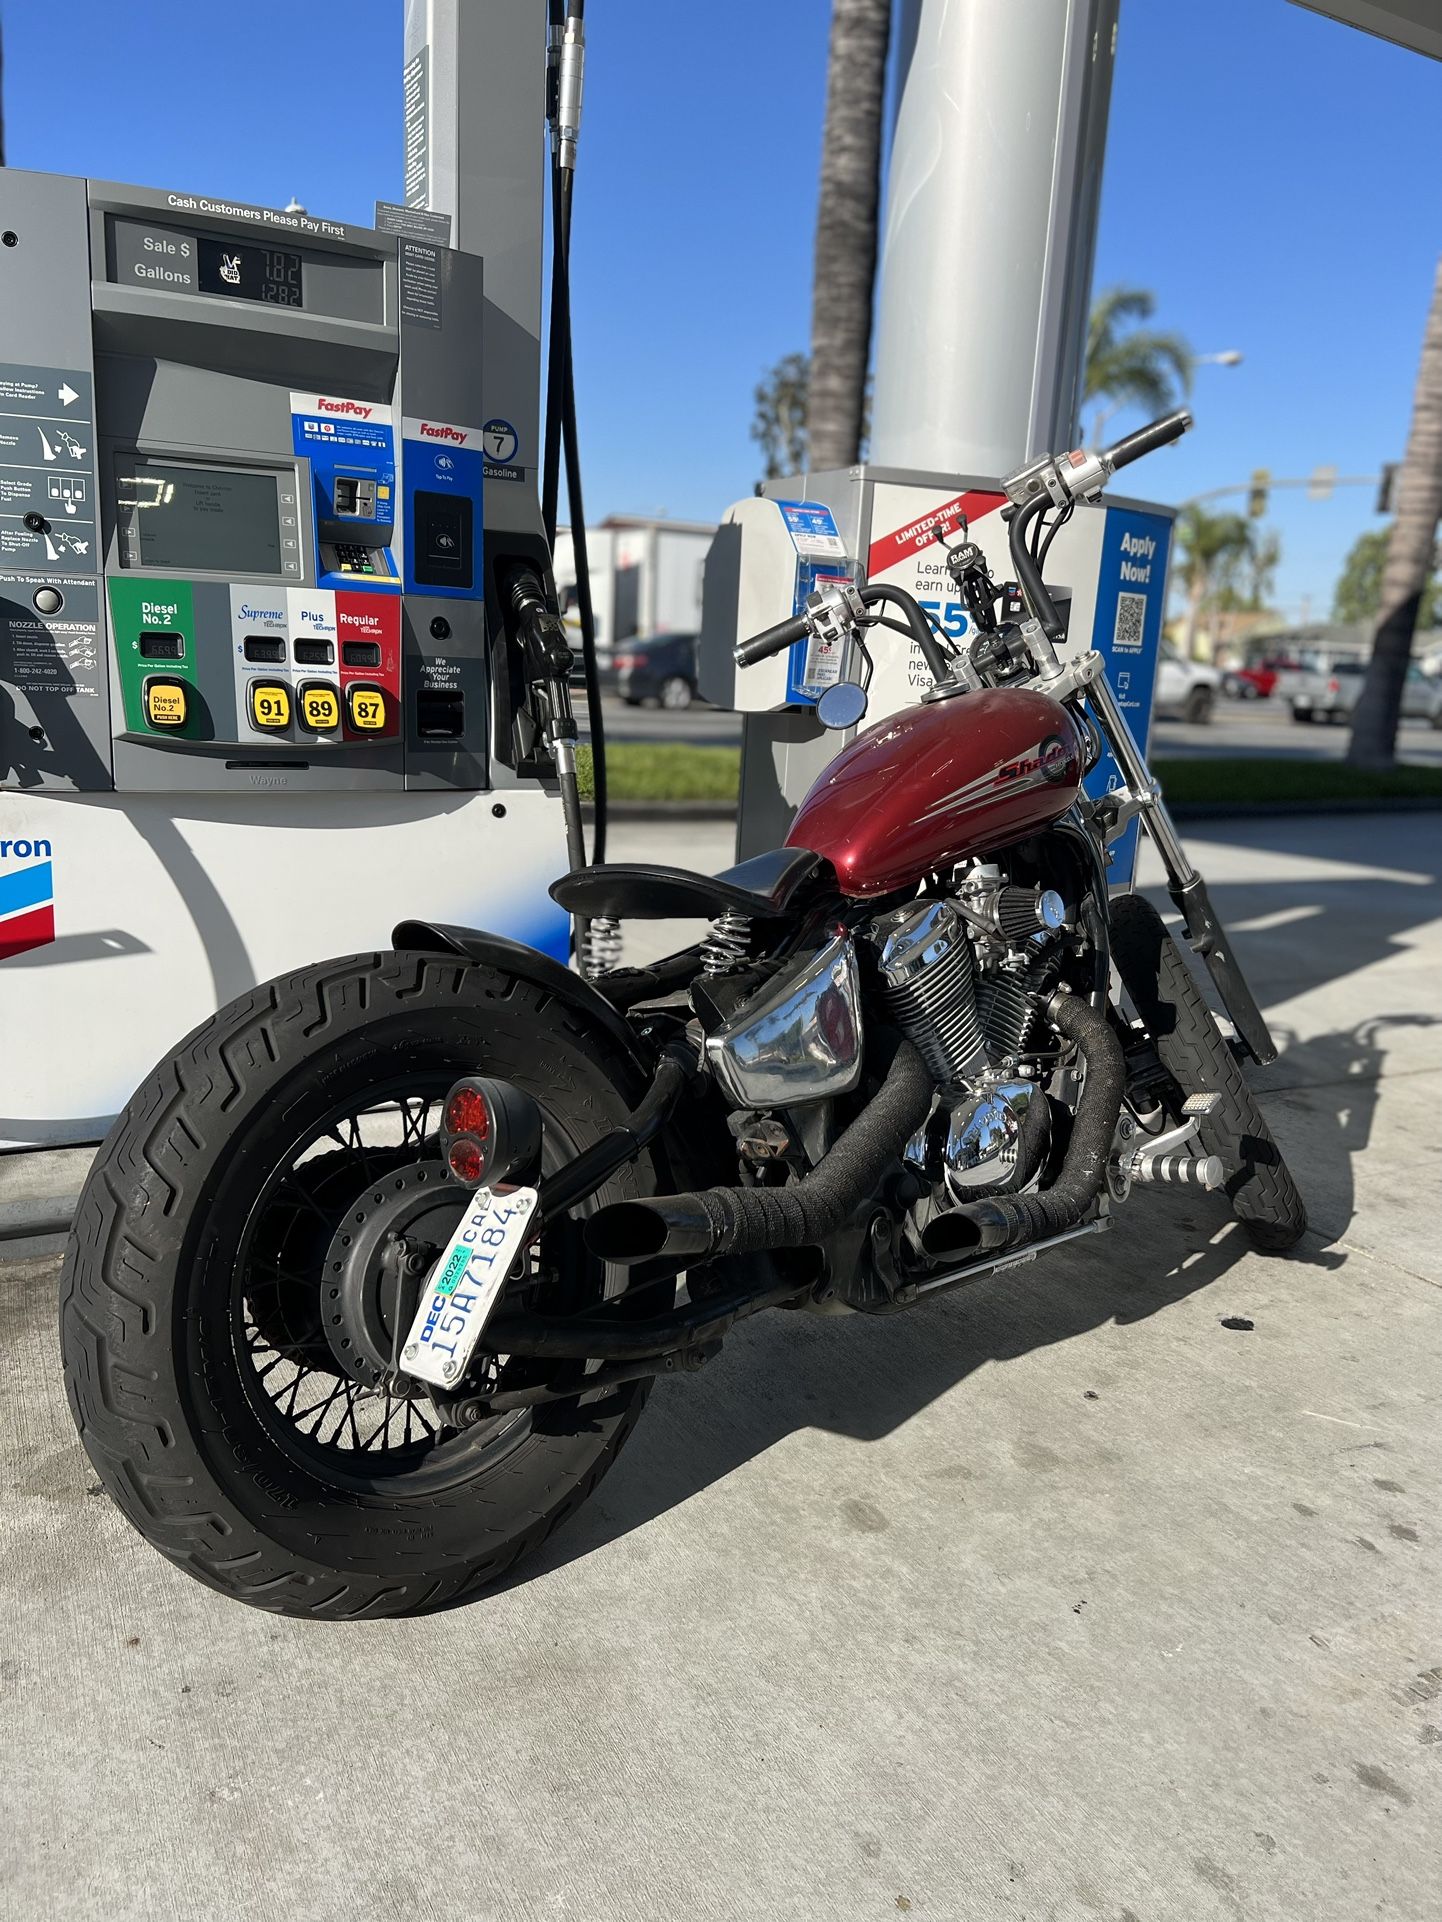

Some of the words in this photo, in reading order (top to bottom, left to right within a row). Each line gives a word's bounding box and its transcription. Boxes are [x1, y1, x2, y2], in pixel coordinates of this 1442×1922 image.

[168, 195, 197, 209] Cash
[200, 200, 261, 220] Customers
[264, 211, 298, 227] Please
[300, 217, 319, 233] Pay
[322, 223, 345, 236] First
[143, 237, 176, 254] Sale
[181, 242, 190, 257] $
[405, 244, 436, 257] ATTENTION
[134, 263, 191, 284] Gallons
[318, 398, 373, 419] FastPay
[420, 423, 468, 444] FastPay
[493, 436, 504, 455] 7
[483, 466, 517, 478] Gasoline
[895, 502, 962, 544] LIMITED-TIME
[915, 521, 951, 546] OFFR!
[1120, 532, 1156, 559] Apply
[950, 546, 974, 564] RAM
[1120, 561, 1151, 583] Now!
[47, 577, 62, 585] With
[63, 579, 96, 587] Attendant
[915, 580, 943, 590] earn
[142, 602, 178, 615] Diesel
[238, 604, 284, 622] Supreme
[301, 611, 324, 622] Plus
[340, 614, 379, 627] Regular
[9, 621, 43, 629] NOZZLE
[45, 622, 96, 632] OPERATION
[132, 640, 139, 650] $
[237, 645, 243, 653] $
[910, 642, 921, 654] in
[435, 658, 446, 666] We
[420, 665, 461, 674] Appreciate
[432, 673, 450, 681] Your
[908, 673, 933, 687] Visa
[424, 680, 458, 689] Business
[153, 696, 180, 705] Diesel
[259, 699, 284, 716] 91
[308, 701, 332, 717] 89
[358, 702, 380, 719] 87
[249, 775, 288, 787] Wayne
[420, 1296, 446, 1342] DEC
[442, 1254, 462, 1285] 2022
[462, 1198, 493, 1243] CAL
[432, 1209, 518, 1359] 15A7184
